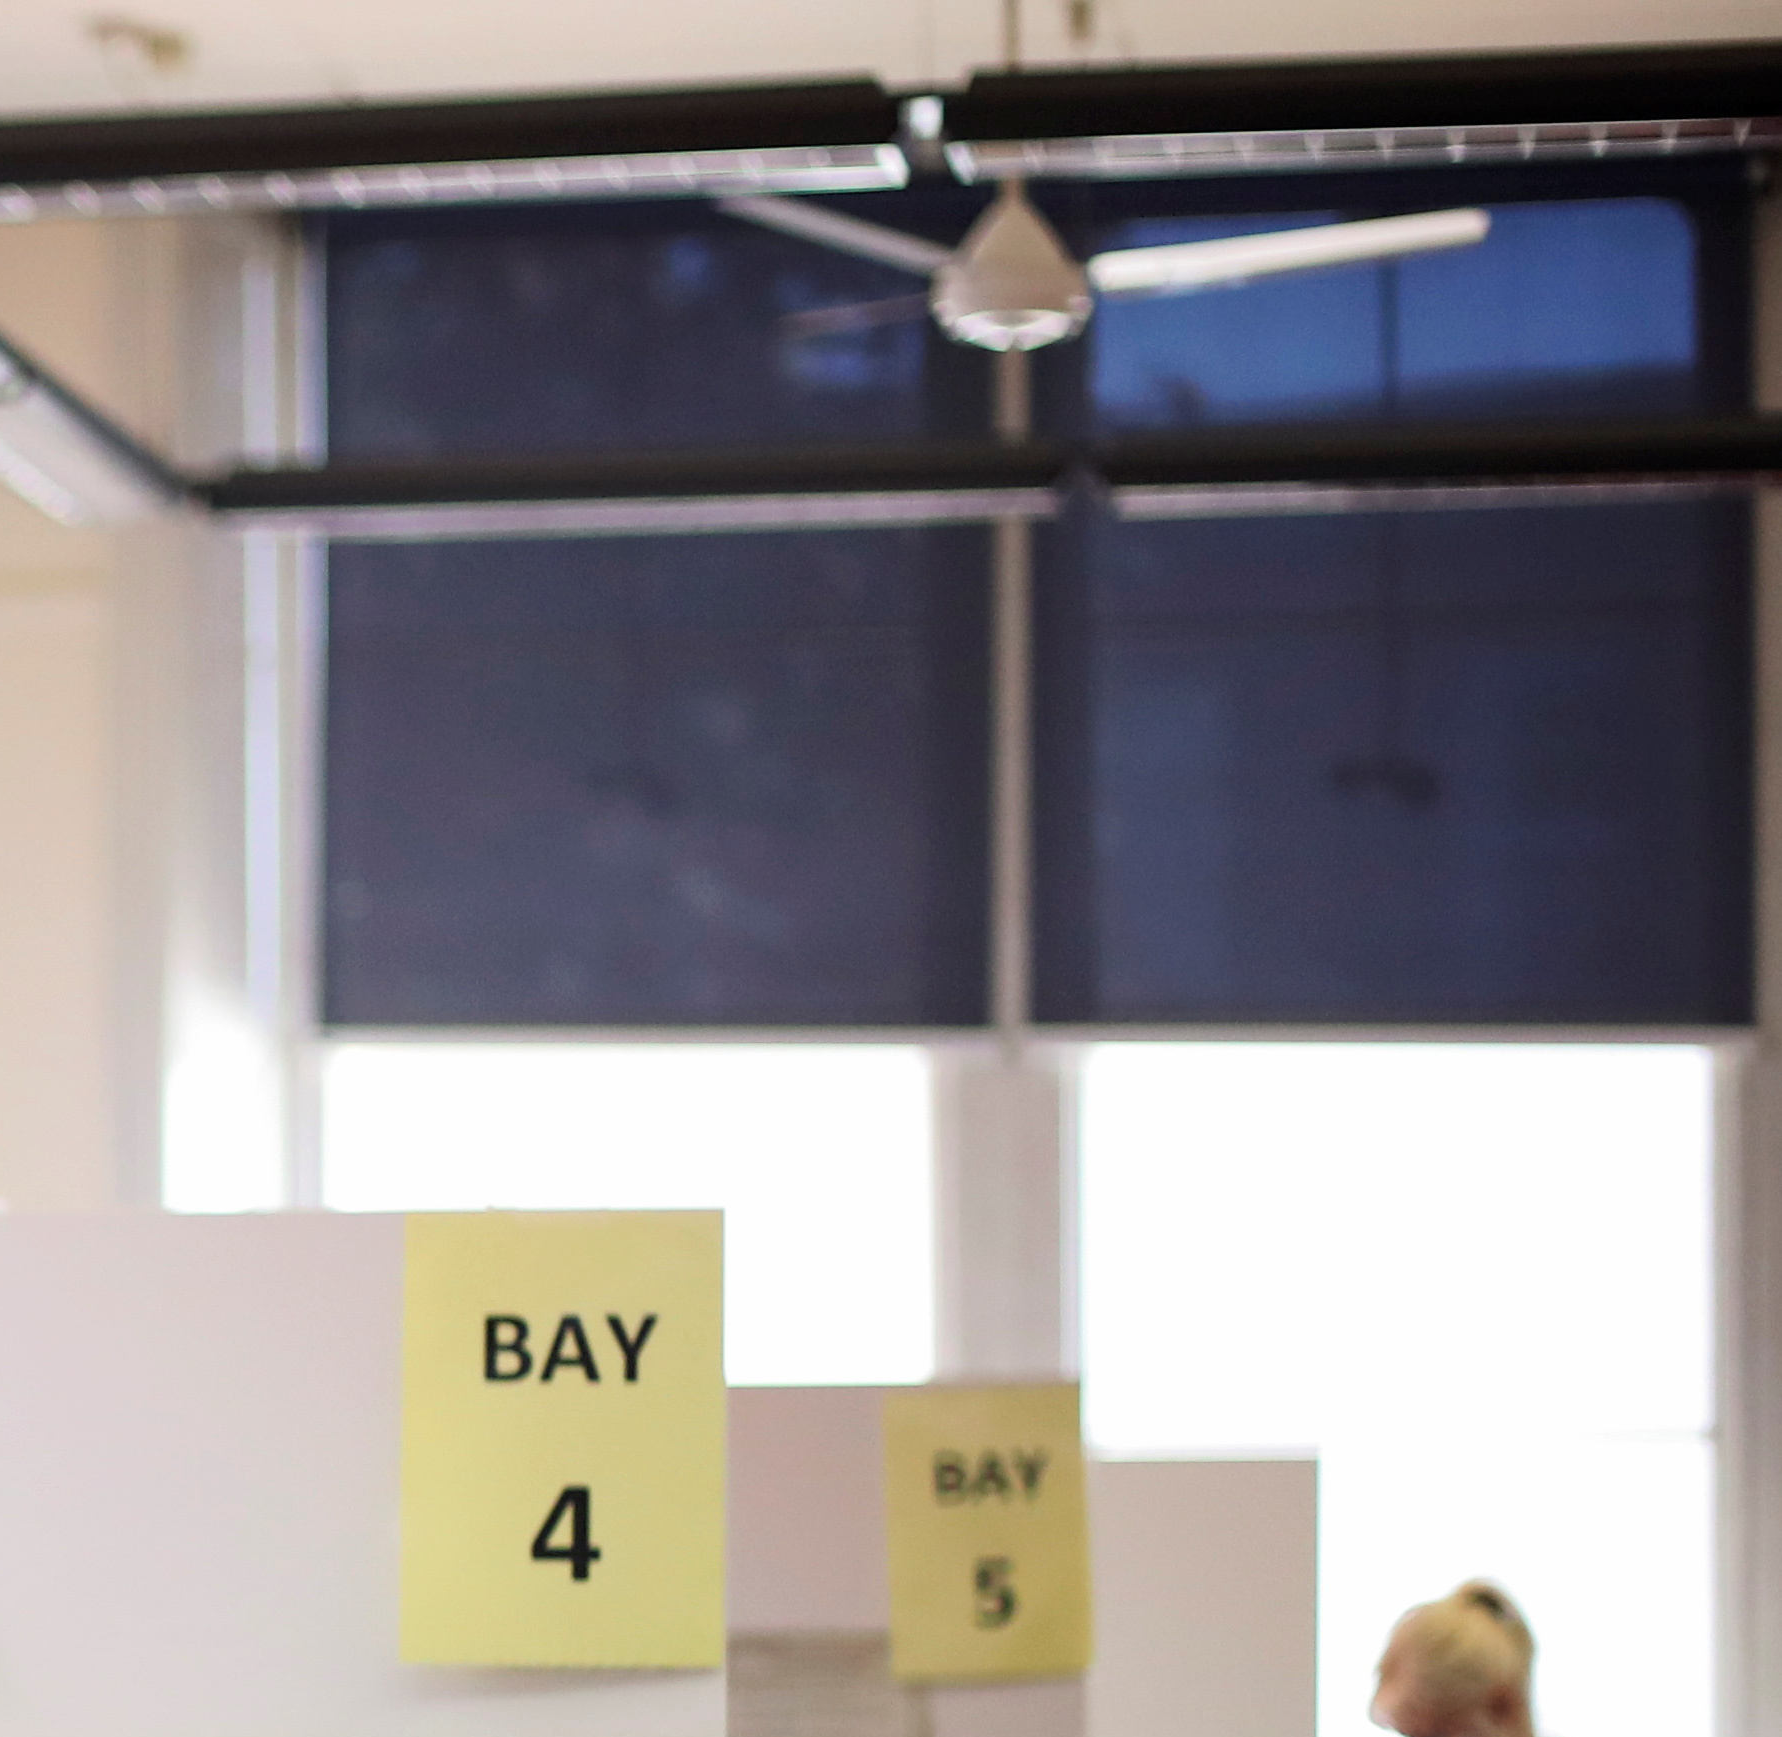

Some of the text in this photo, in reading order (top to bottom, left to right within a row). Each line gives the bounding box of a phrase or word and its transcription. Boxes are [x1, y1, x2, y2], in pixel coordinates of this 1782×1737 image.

[484, 1314, 657, 1383] BAY
[933, 1450, 1048, 1504] BAY
[531, 1485, 601, 1581] 4
[973, 1556, 1017, 1630] 5
